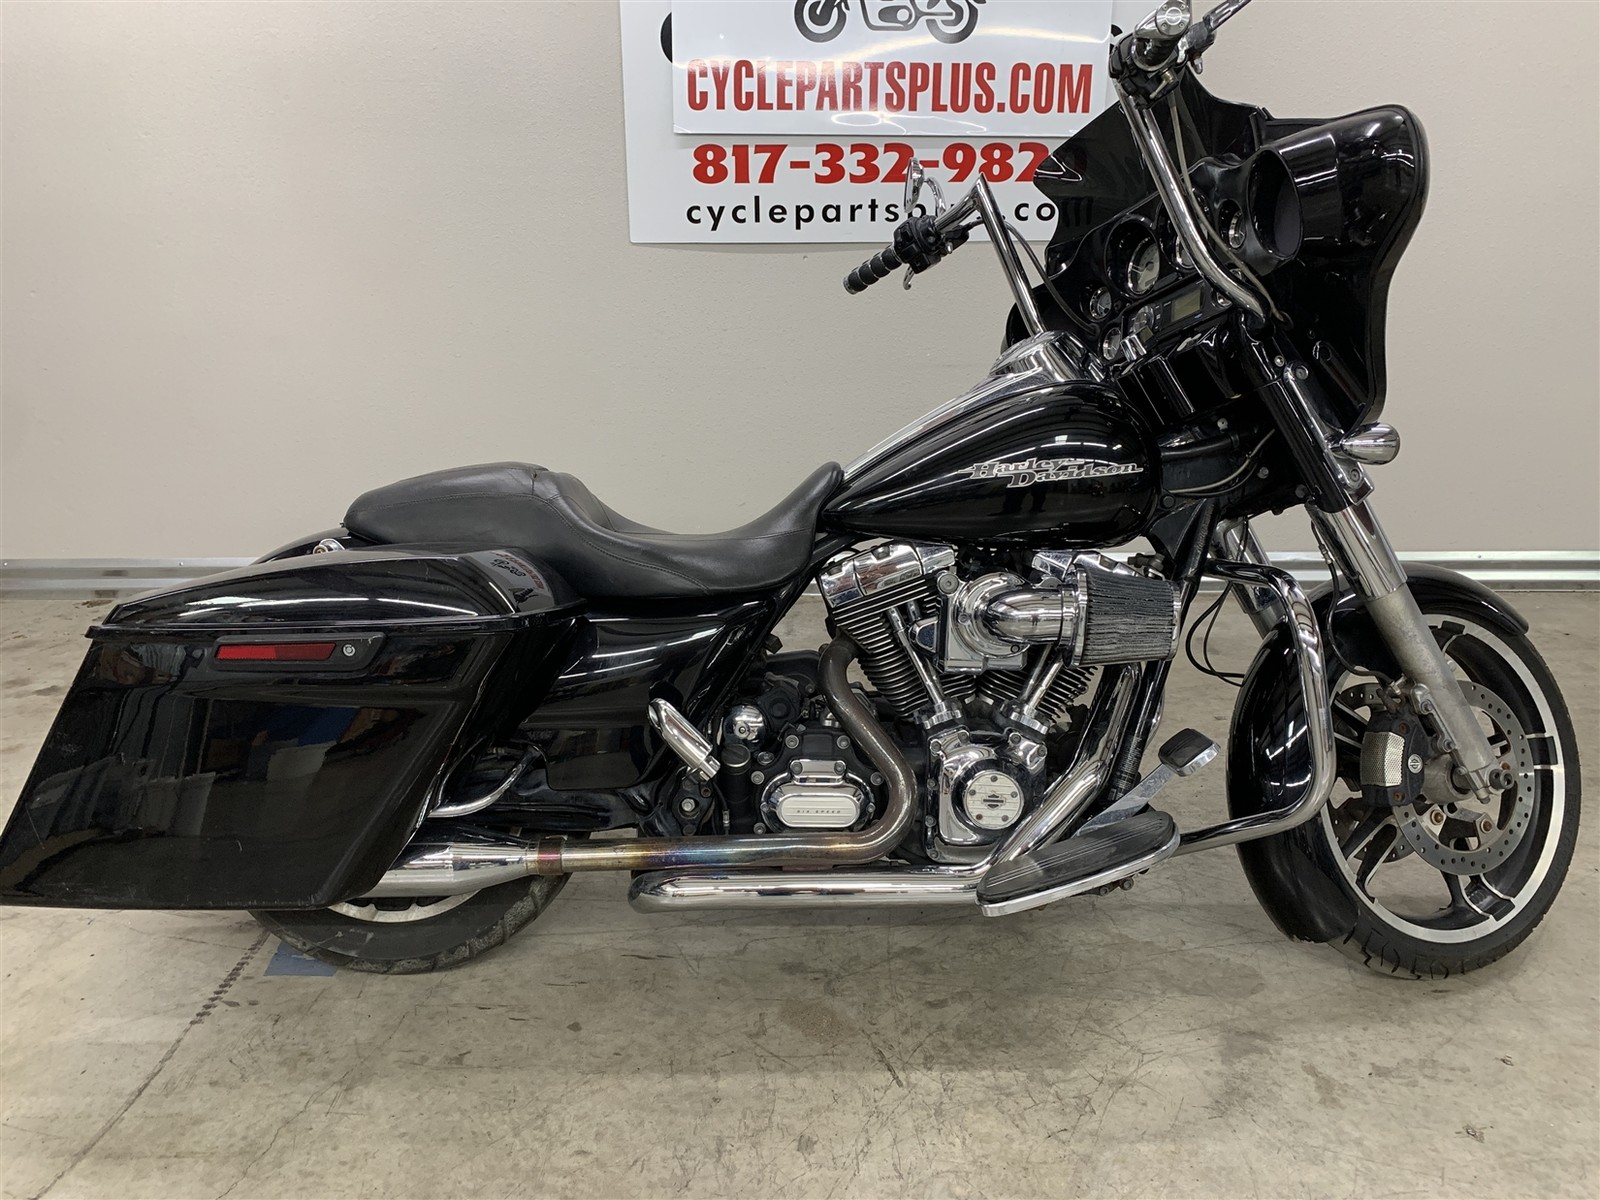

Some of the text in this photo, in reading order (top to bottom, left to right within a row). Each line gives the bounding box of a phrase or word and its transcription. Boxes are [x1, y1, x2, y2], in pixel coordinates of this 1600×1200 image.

[687, 60, 1093, 114] CYCLEPARTSPLUS.COM
[693, 142, 1087, 184] 817-332-982
[1000, 462, 1144, 488] Davidson
